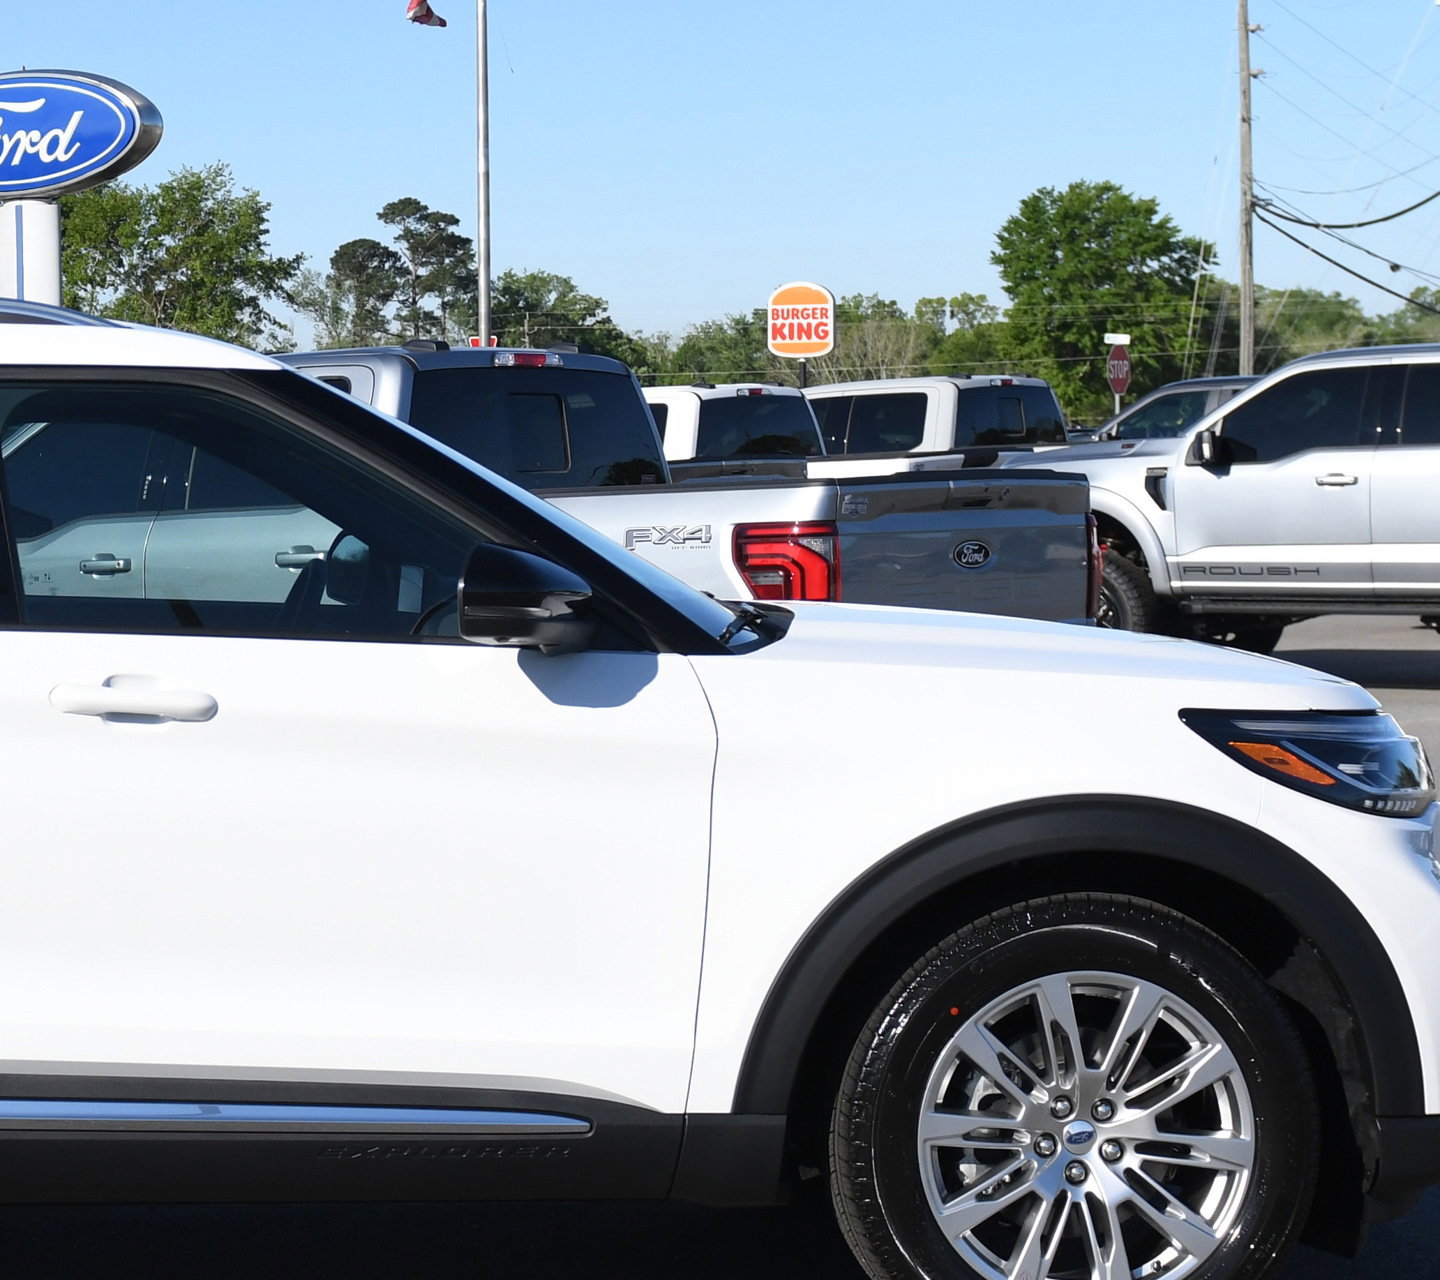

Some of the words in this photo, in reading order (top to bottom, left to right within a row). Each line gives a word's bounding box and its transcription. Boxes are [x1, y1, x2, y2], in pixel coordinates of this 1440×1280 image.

[772, 307, 829, 321] BURGER
[771, 321, 829, 341] KING
[1110, 359, 1129, 379] STOP
[623, 523, 712, 552] FX4
[961, 544, 985, 563] Ford
[1183, 566, 1320, 577] ROUSH
[318, 1145, 572, 1160] EXPLORER
